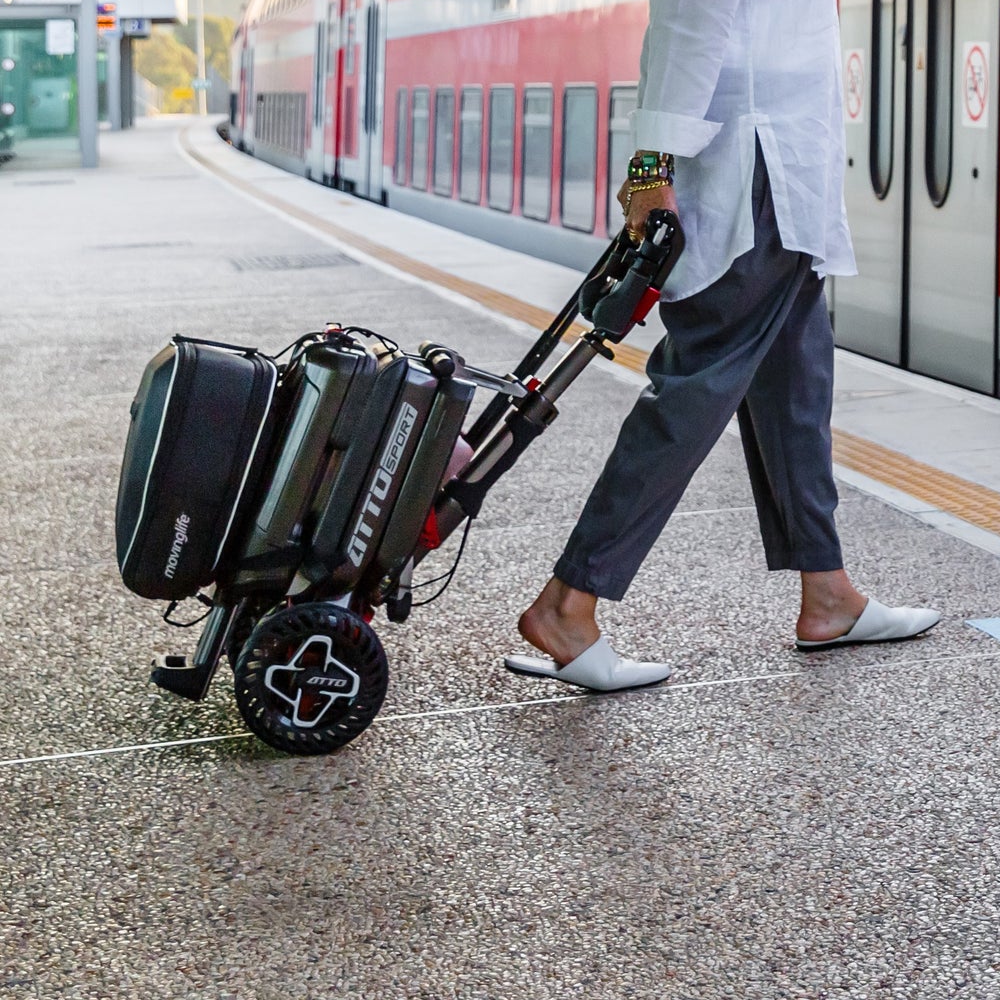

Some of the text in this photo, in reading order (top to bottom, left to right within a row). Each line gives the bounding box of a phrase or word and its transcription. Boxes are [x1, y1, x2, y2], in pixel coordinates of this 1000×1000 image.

[348, 407, 416, 567] ATTO SPORT
[164, 512, 190, 579] movinglife
[306, 676, 347, 687] ATTO
